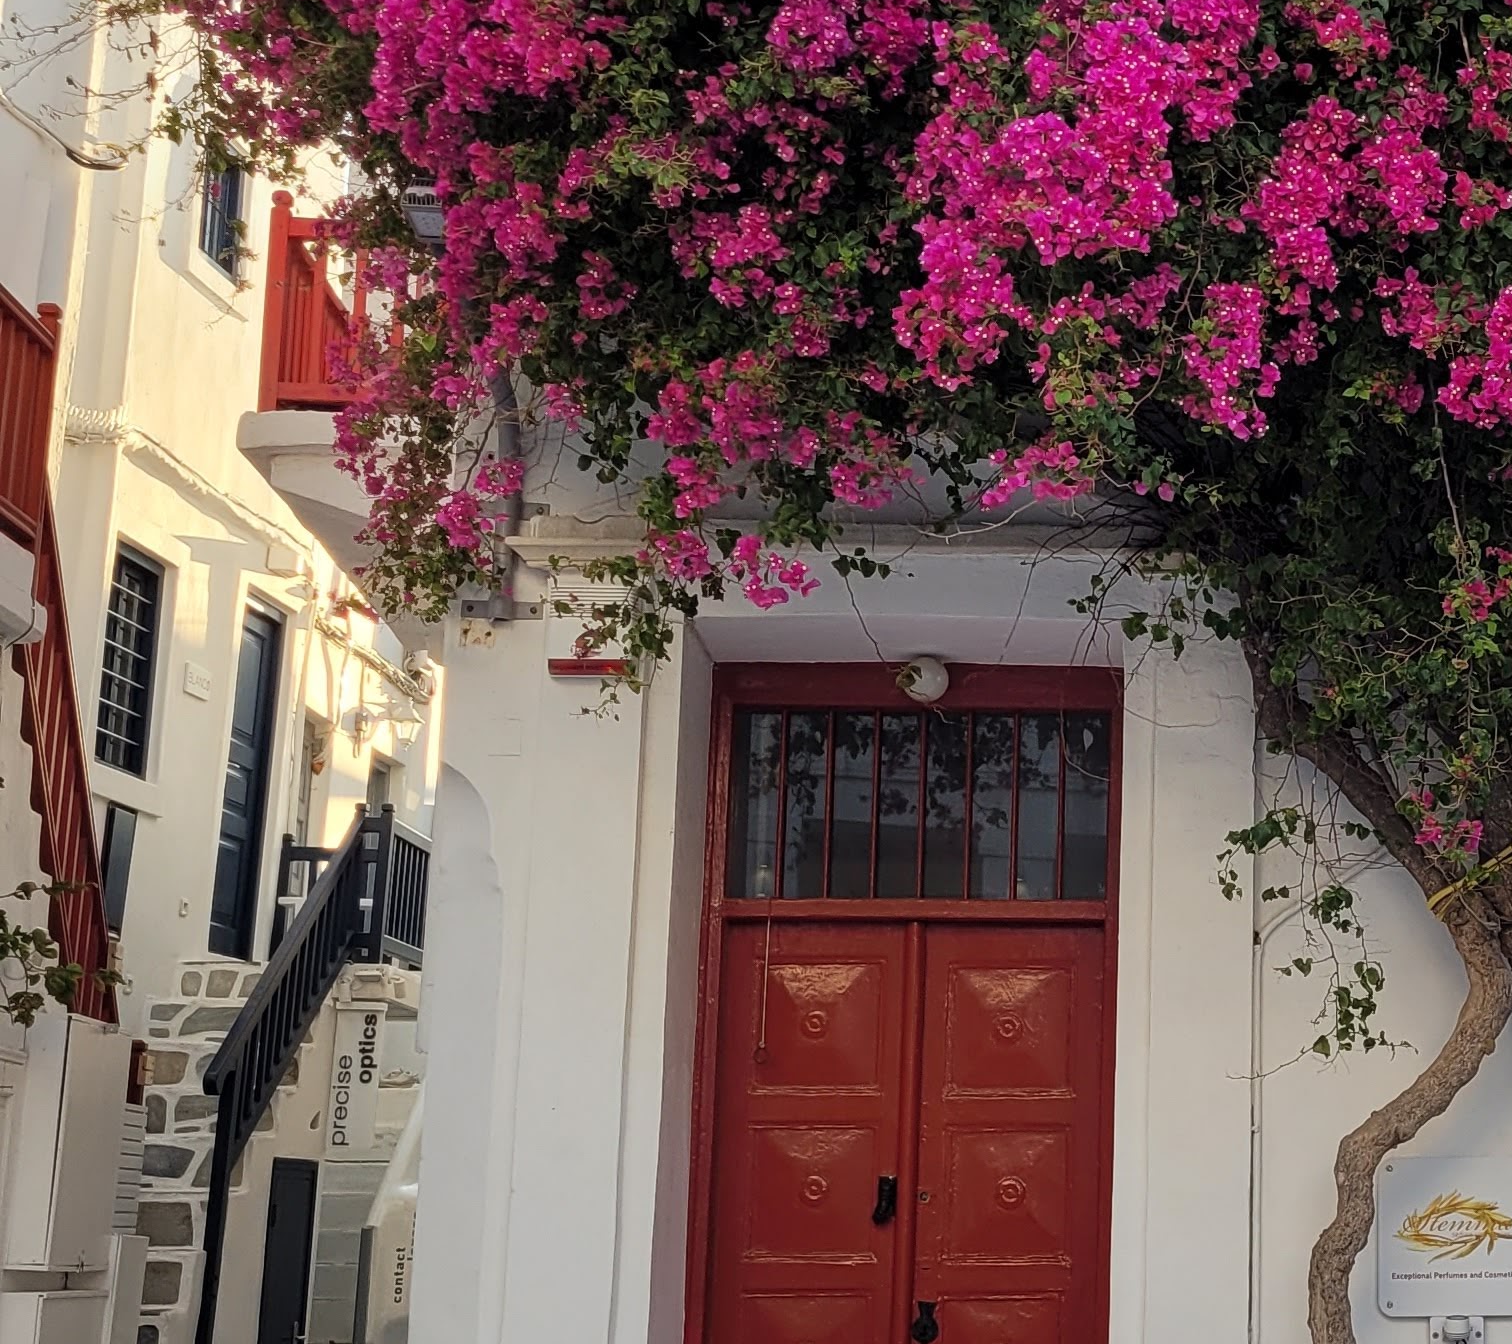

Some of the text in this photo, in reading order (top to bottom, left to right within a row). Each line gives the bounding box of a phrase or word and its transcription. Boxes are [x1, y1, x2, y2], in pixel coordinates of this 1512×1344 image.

[358, 1013, 378, 1084] optics
[331, 1055, 353, 1146] precise
[393, 1247, 406, 1304] contact
[1391, 1272, 1432, 1281] Exceptional
